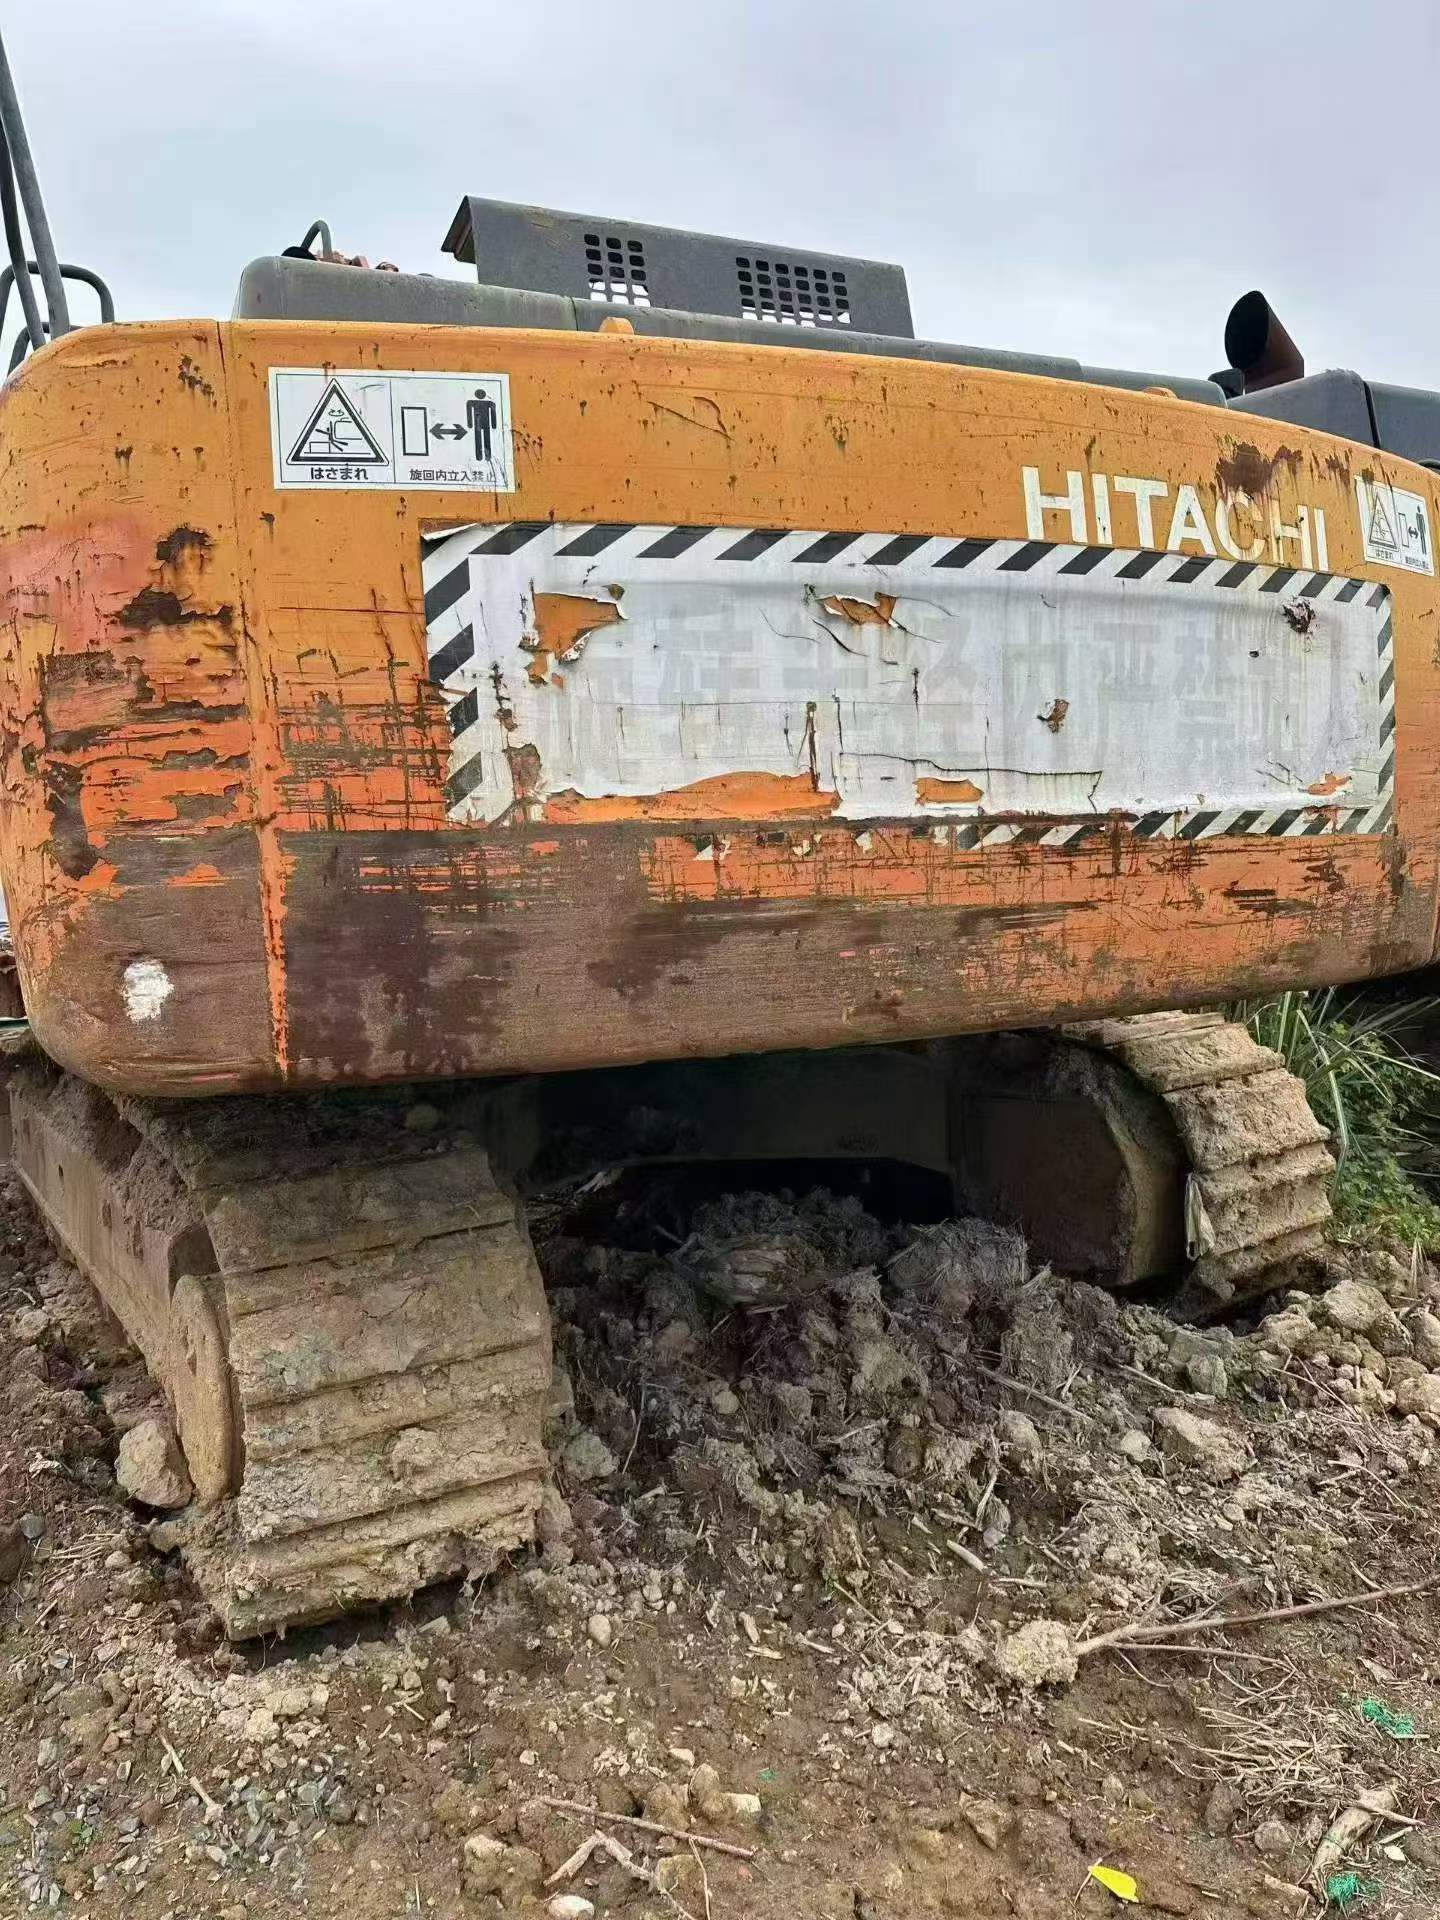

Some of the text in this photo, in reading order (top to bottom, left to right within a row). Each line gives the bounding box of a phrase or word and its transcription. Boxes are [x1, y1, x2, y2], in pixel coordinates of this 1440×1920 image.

[311, 467, 369, 481] はさまれ
[1022, 465, 1329, 572] HITACHI
